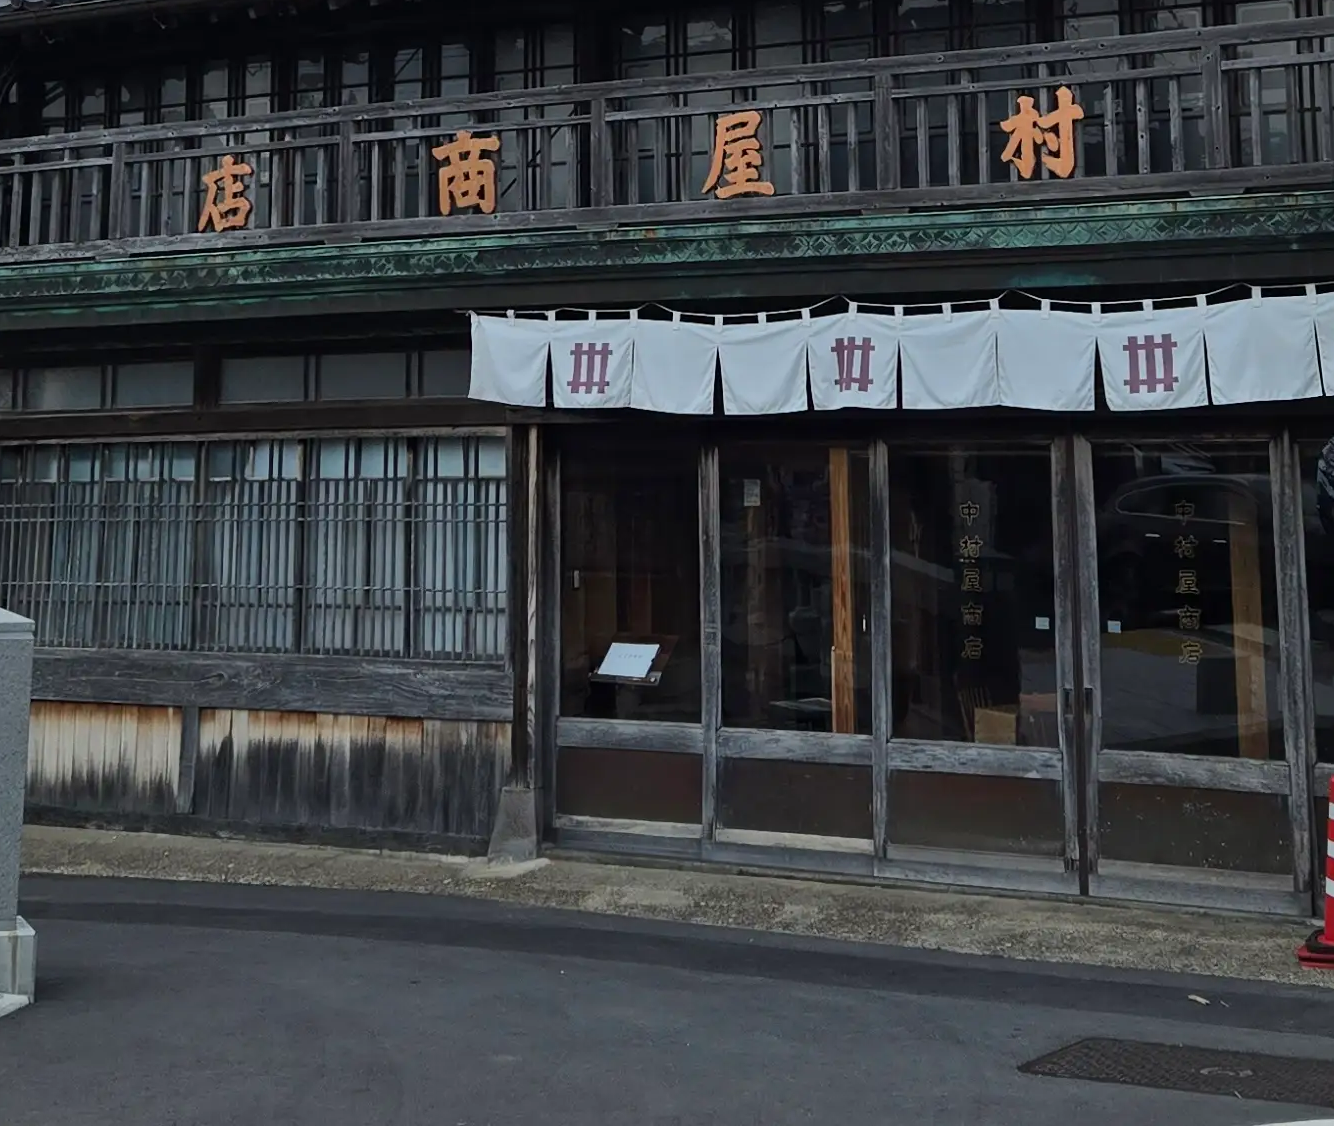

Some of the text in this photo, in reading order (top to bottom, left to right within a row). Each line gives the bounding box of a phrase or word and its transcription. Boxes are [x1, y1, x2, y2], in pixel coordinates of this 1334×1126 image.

[959, 500, 984, 659] 中村屋商店
[1174, 500, 1203, 666] 中村屋商店
